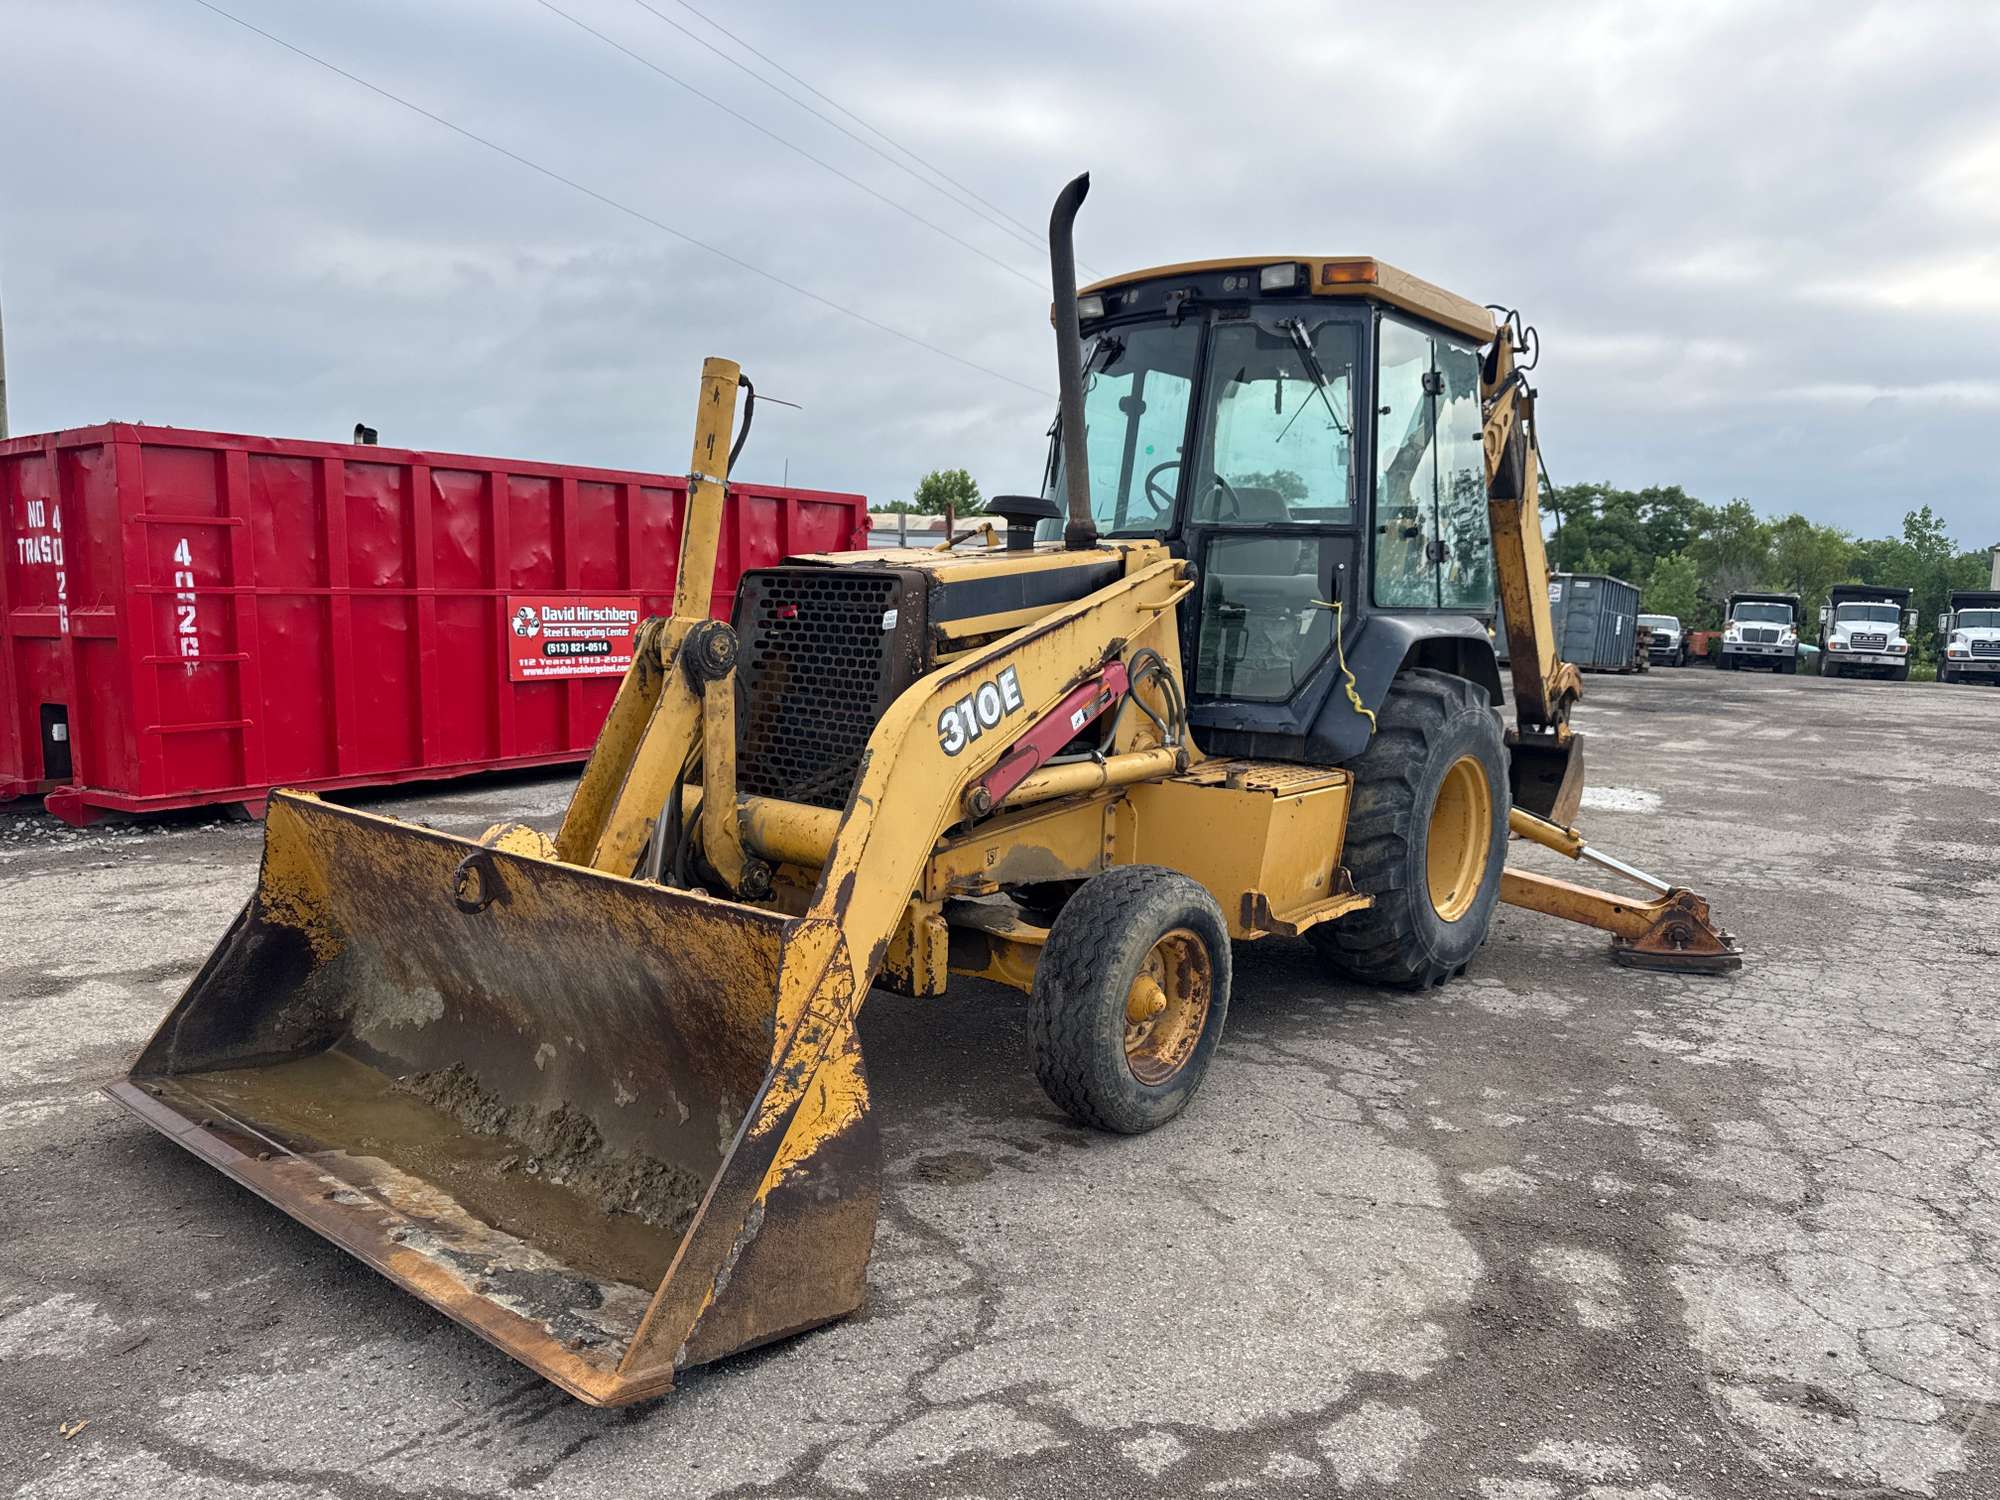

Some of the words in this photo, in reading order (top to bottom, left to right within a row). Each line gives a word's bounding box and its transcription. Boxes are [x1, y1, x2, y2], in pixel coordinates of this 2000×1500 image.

[27, 500, 45, 528] NO
[17, 535, 52, 565] TRAS
[542, 606, 575, 621] David
[577, 606, 638, 624] Hirschberg
[543, 628, 564, 638] Steel
[564, 628, 570, 637] &
[571, 628, 606, 639] Recycling
[606, 628, 630, 637] Center
[547, 642, 569, 655] (513)
[570, 642, 608, 653] 821-0514
[518, 658, 536, 666] 112
[538, 657, 575, 666] Years!
[578, 656, 631, 665] 1913-2025
[938, 664, 1024, 757] 310E
